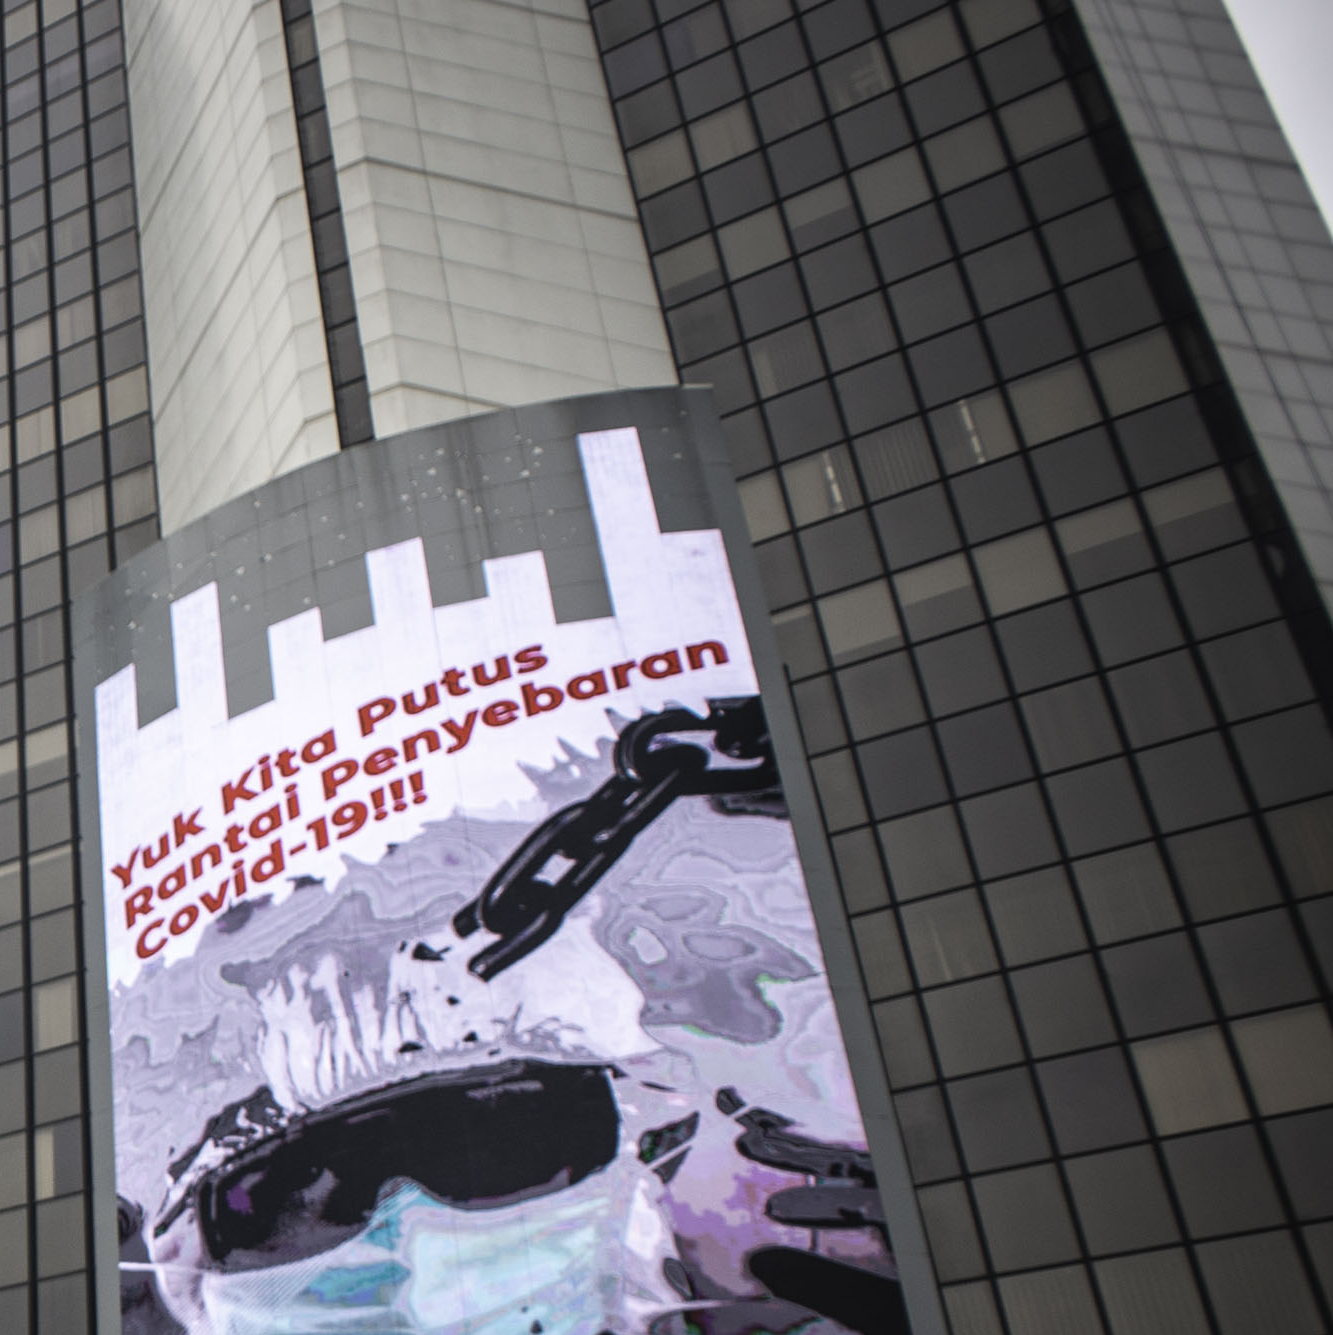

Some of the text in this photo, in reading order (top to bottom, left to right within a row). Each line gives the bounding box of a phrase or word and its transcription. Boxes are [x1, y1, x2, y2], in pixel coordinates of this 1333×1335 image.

[110, 644, 549, 889] Yuk Kita Putus
[124, 639, 729, 930] Rantai Penyebaran
[135, 770, 429, 961] Covid-19!!!
